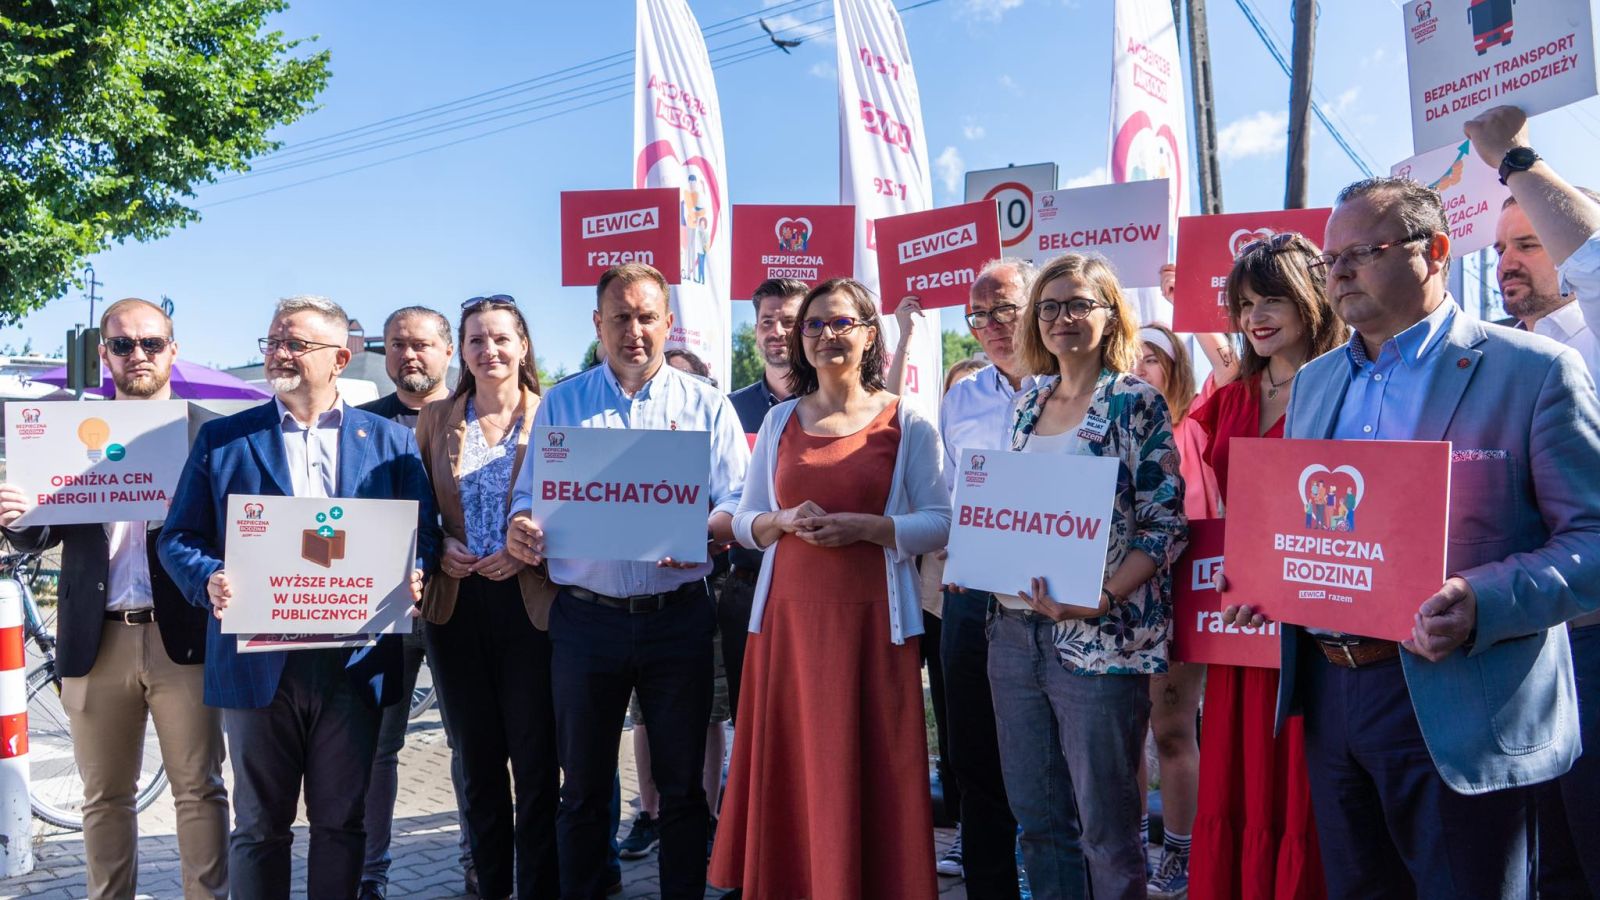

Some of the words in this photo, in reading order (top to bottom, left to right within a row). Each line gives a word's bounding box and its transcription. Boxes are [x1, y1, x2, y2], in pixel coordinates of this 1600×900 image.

[1424, 67, 1491, 104] BEZPŁATNY
[1494, 33, 1576, 76] TRANSPORT
[1426, 105, 1449, 122] DLA
[1452, 87, 1491, 112] DZIECI
[1495, 85, 1499, 97] I
[1502, 54, 1578, 95] MŁODZIEŻY
[1443, 194, 1466, 211] UGA
[1449, 200, 1488, 225] ZACJA
[587, 211, 655, 235] LEWICA
[1450, 223, 1473, 239] TUR
[903, 228, 973, 259] LEWICA
[1039, 223, 1162, 251] BEŁCHATÓW
[588, 249, 654, 267] razem
[761, 255, 824, 265] BEZPIECZNA
[769, 268, 816, 279] RODZINA
[906, 267, 975, 292] razem
[1078, 430, 1103, 442] razem
[51, 472, 118, 487] OBNIŻKA
[123, 473, 153, 485] CEN
[38, 492, 97, 505] ENERGII
[101, 492, 105, 503] I
[110, 490, 166, 503] PALIWA
[542, 480, 700, 505] BEŁCHATÓW
[959, 505, 1102, 540] BEŁCHATÓW
[1274, 534, 1384, 561] BEZPIECZNA
[269, 574, 326, 588] WYŻSZE
[329, 577, 373, 588] PŁACE
[1286, 562, 1369, 587] RODZINA
[273, 593, 288, 604] W
[292, 593, 368, 605] USŁUGACH
[1328, 594, 1353, 603] razem
[271, 609, 368, 620] PUBLICZNYCH
